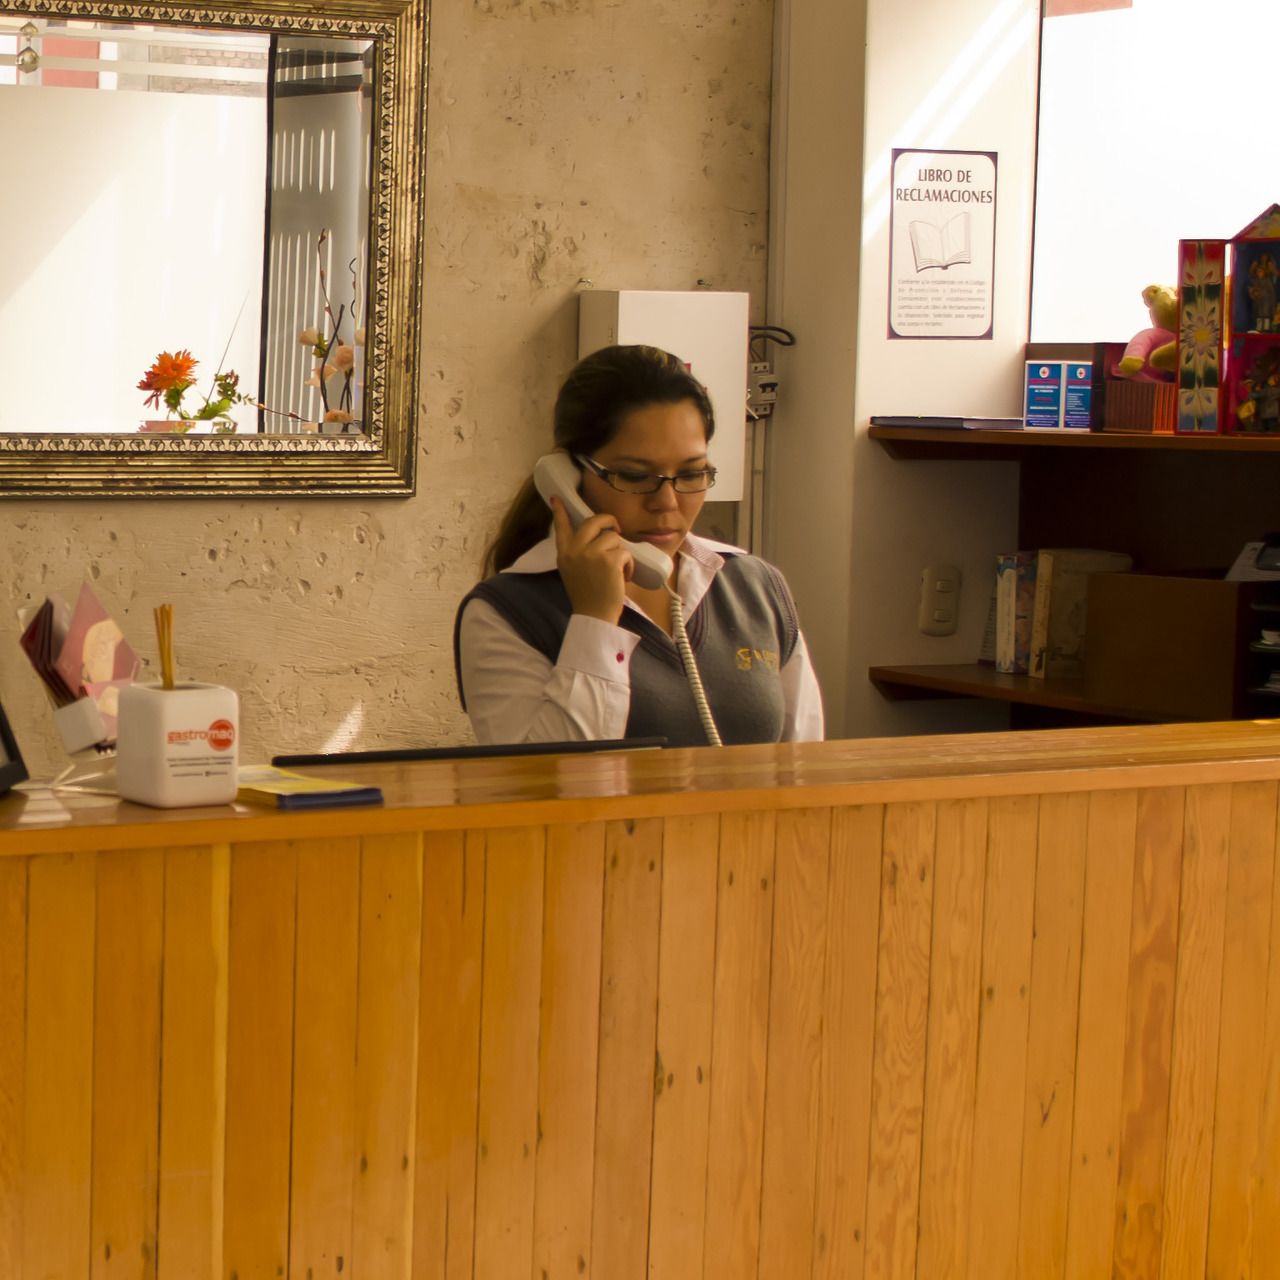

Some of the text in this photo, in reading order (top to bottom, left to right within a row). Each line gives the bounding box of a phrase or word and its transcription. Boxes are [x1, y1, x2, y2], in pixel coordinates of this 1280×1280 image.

[918, 168, 972, 183] LIBRO DE
[896, 188, 993, 204] RECLAMACIONES
